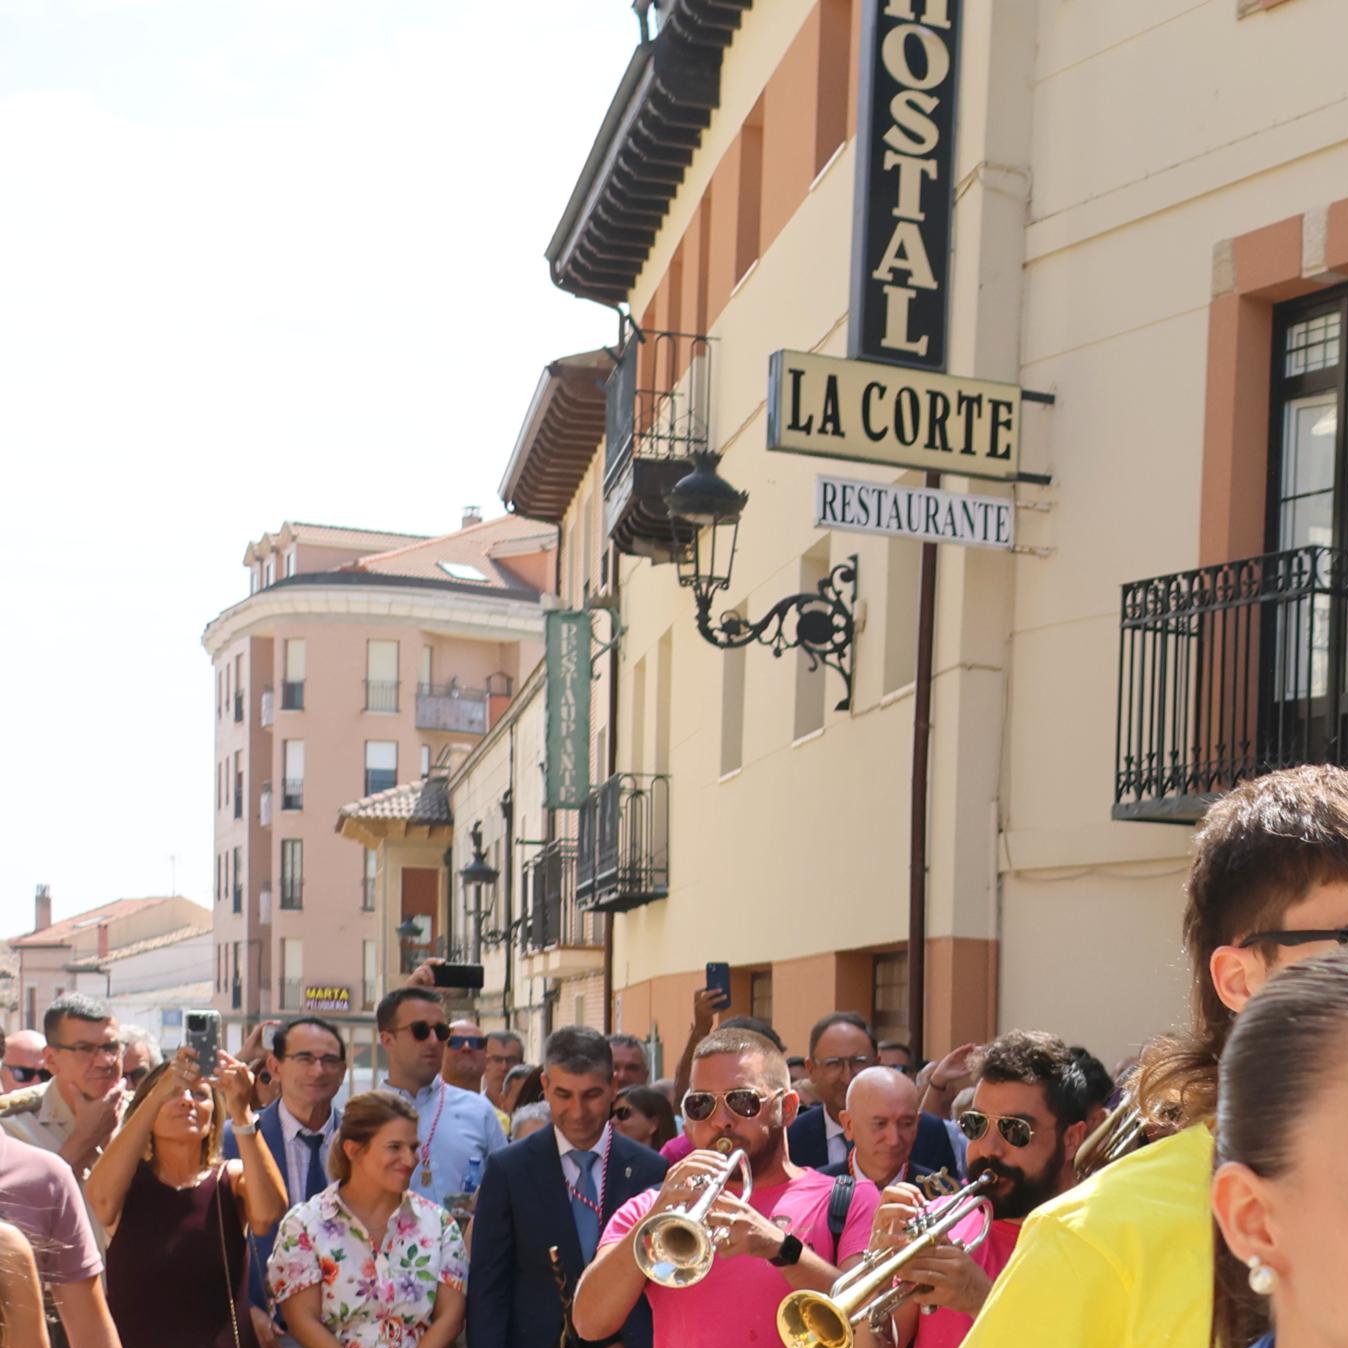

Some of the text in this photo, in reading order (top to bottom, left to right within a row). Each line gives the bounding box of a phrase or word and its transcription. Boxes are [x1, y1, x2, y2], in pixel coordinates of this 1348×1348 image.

[787, 368, 1014, 461] LA CORTE
[820, 480, 1012, 545] RESTAURANTE
[560, 622, 577, 803] RESTAURANTE
[306, 987, 350, 999] MARTA
